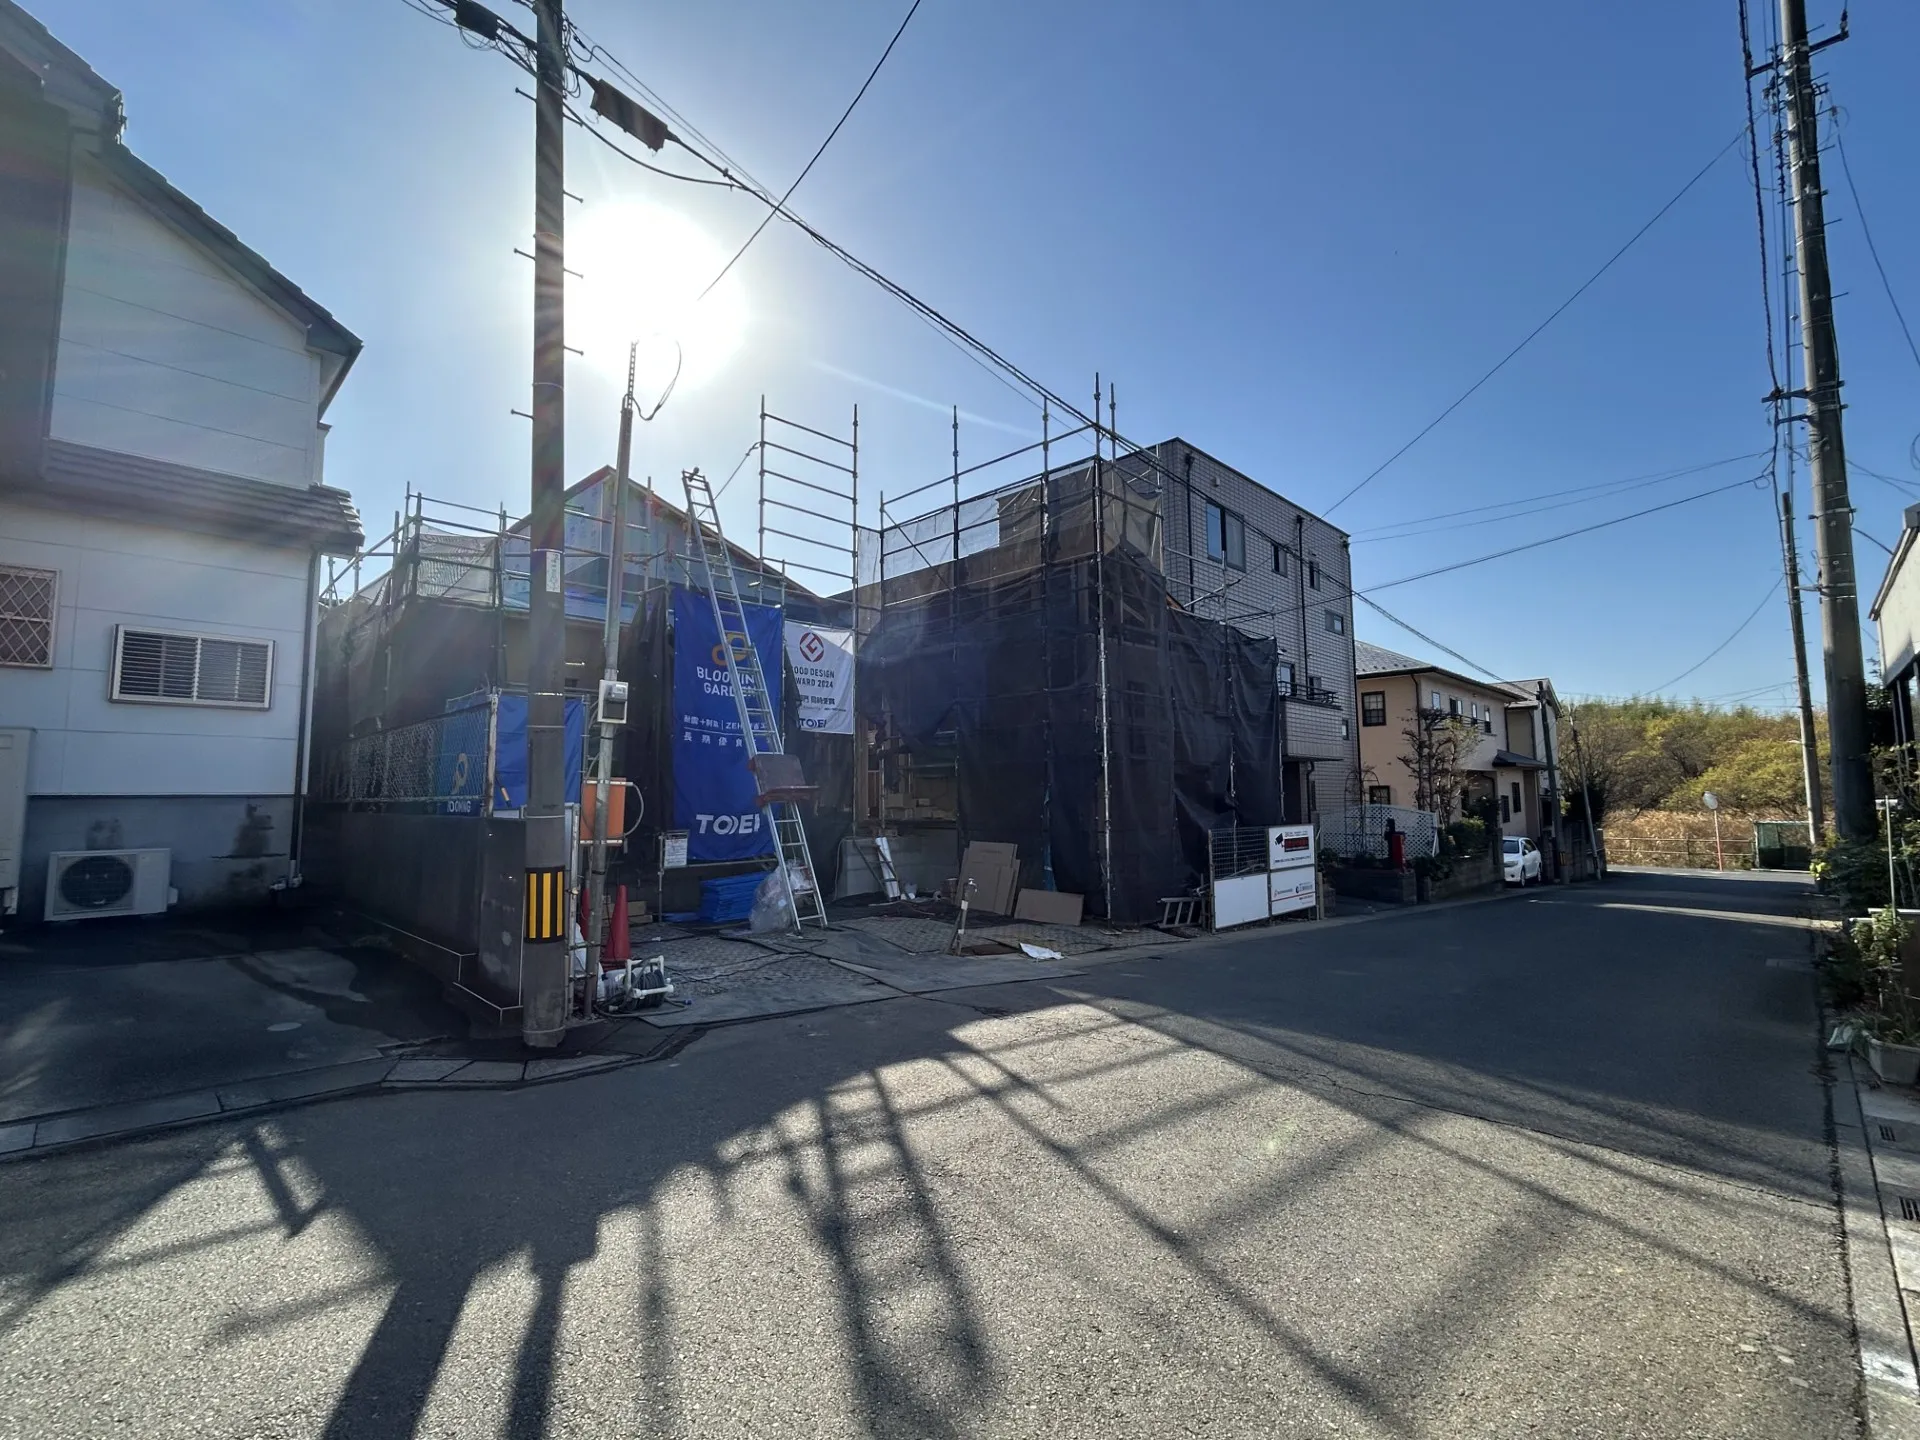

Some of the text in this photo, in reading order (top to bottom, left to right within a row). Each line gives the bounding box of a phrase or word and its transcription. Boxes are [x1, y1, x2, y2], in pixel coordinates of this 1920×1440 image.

[793, 666, 835, 678] OOD DESIGN
[795, 677, 833, 688] WARD 2024
[696, 813, 760, 835] TOEI
